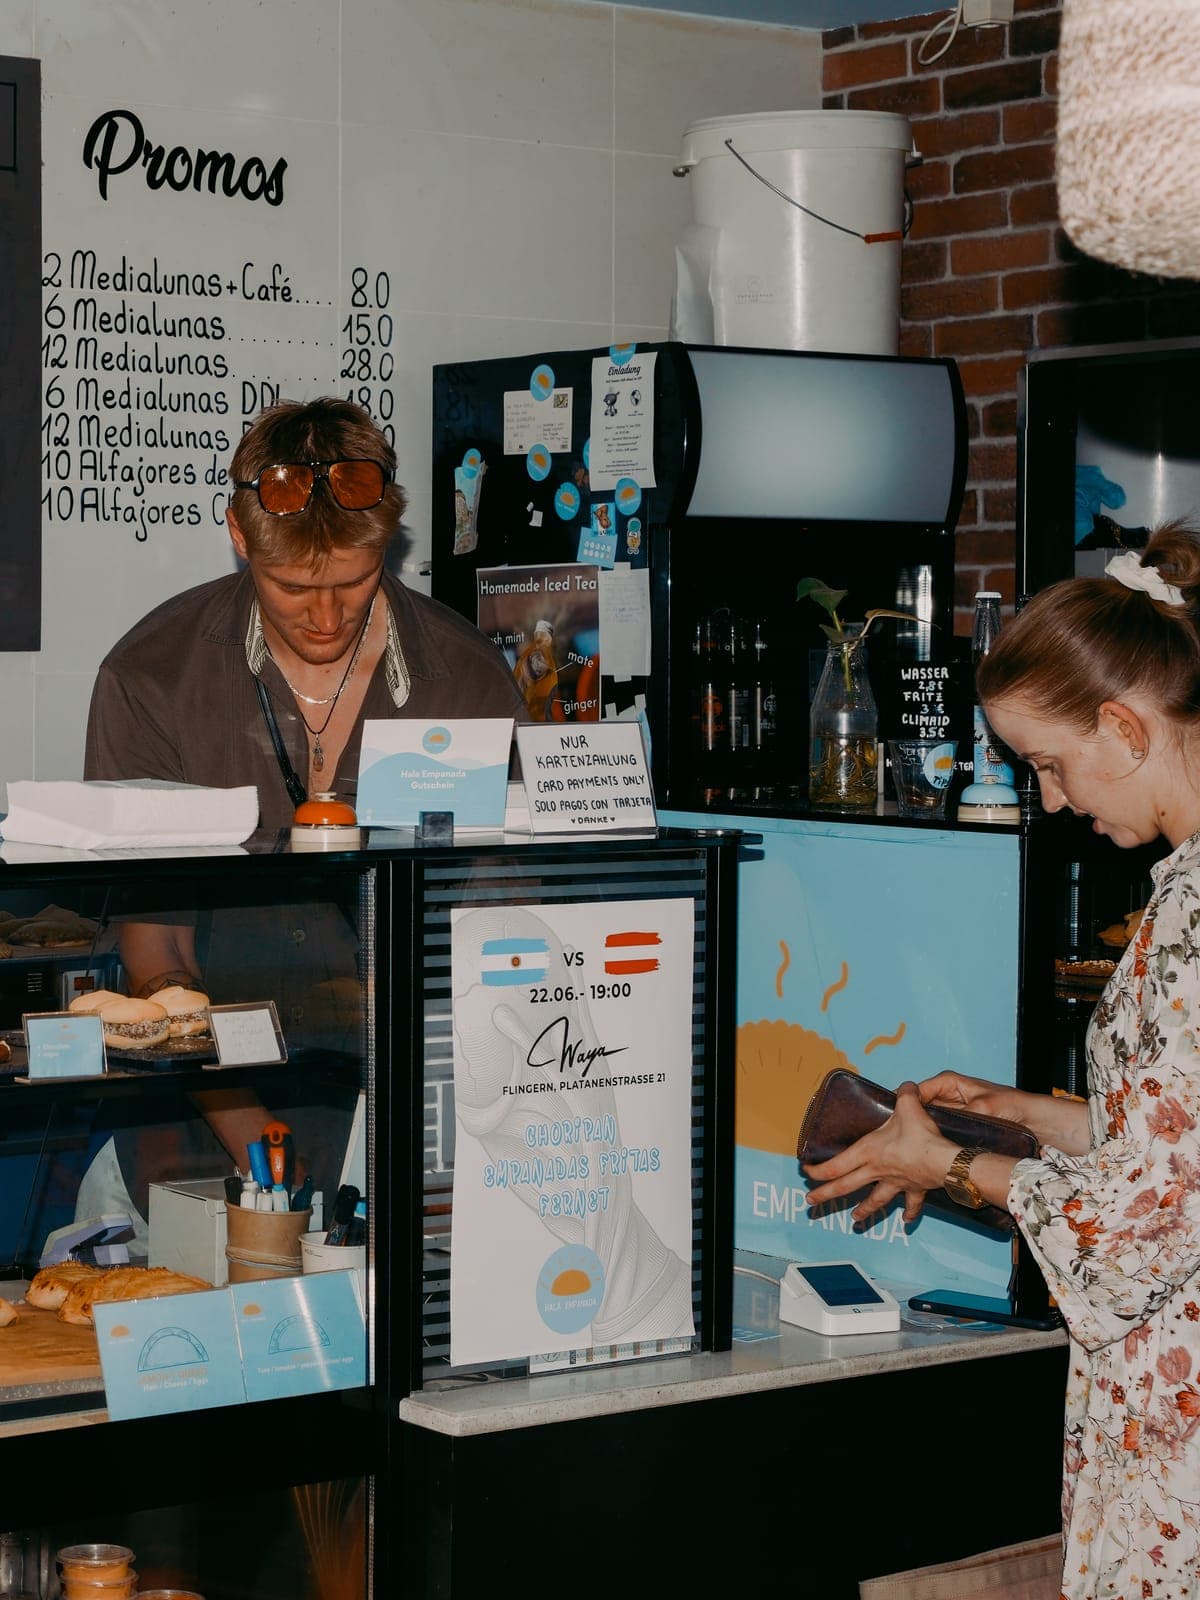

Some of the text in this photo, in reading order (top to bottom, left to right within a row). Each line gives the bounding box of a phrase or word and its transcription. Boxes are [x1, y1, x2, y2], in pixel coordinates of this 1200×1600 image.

[83, 109, 288, 207] Promos
[41, 253, 62, 288] 2
[351, 267, 390, 309] 8.0
[44, 293, 66, 330] 6
[343, 314, 393, 347] 15.0
[42, 334, 68, 369] 12
[340, 348, 394, 382] 28.0
[45, 376, 66, 409] 6
[76, 377, 230, 415] Medialunas
[42, 413, 70, 447] 12
[79, 415, 230, 451] Medialunas
[42, 450, 70, 482] 10
[80, 450, 196, 497] Alfajores
[43, 486, 73, 522] 10
[80, 487, 202, 542] Alfajores
[480, 575, 597, 595] Homemade Iced Tea
[505, 632, 525, 645] mint
[567, 651, 594, 668] mate
[901, 667, 949, 680] WASSER
[903, 691, 944, 702] FRITZ
[564, 698, 597, 714] ginger
[902, 713, 950, 726] CLIMAID
[560, 735, 589, 750] NUR
[536, 754, 637, 769] KARTENZAHLUNG
[538, 774, 645, 793] CARD PAYMENTS ONLY
[534, 797, 652, 813] SOLO PAGOS CON TARJETA
[578, 816, 608, 824] DANKE
[563, 952, 585, 967] VS
[590, 983, 632, 1000] 19:00
[502, 1073, 666, 1096] FLINGERN, PLATANENSTRASSE 21
